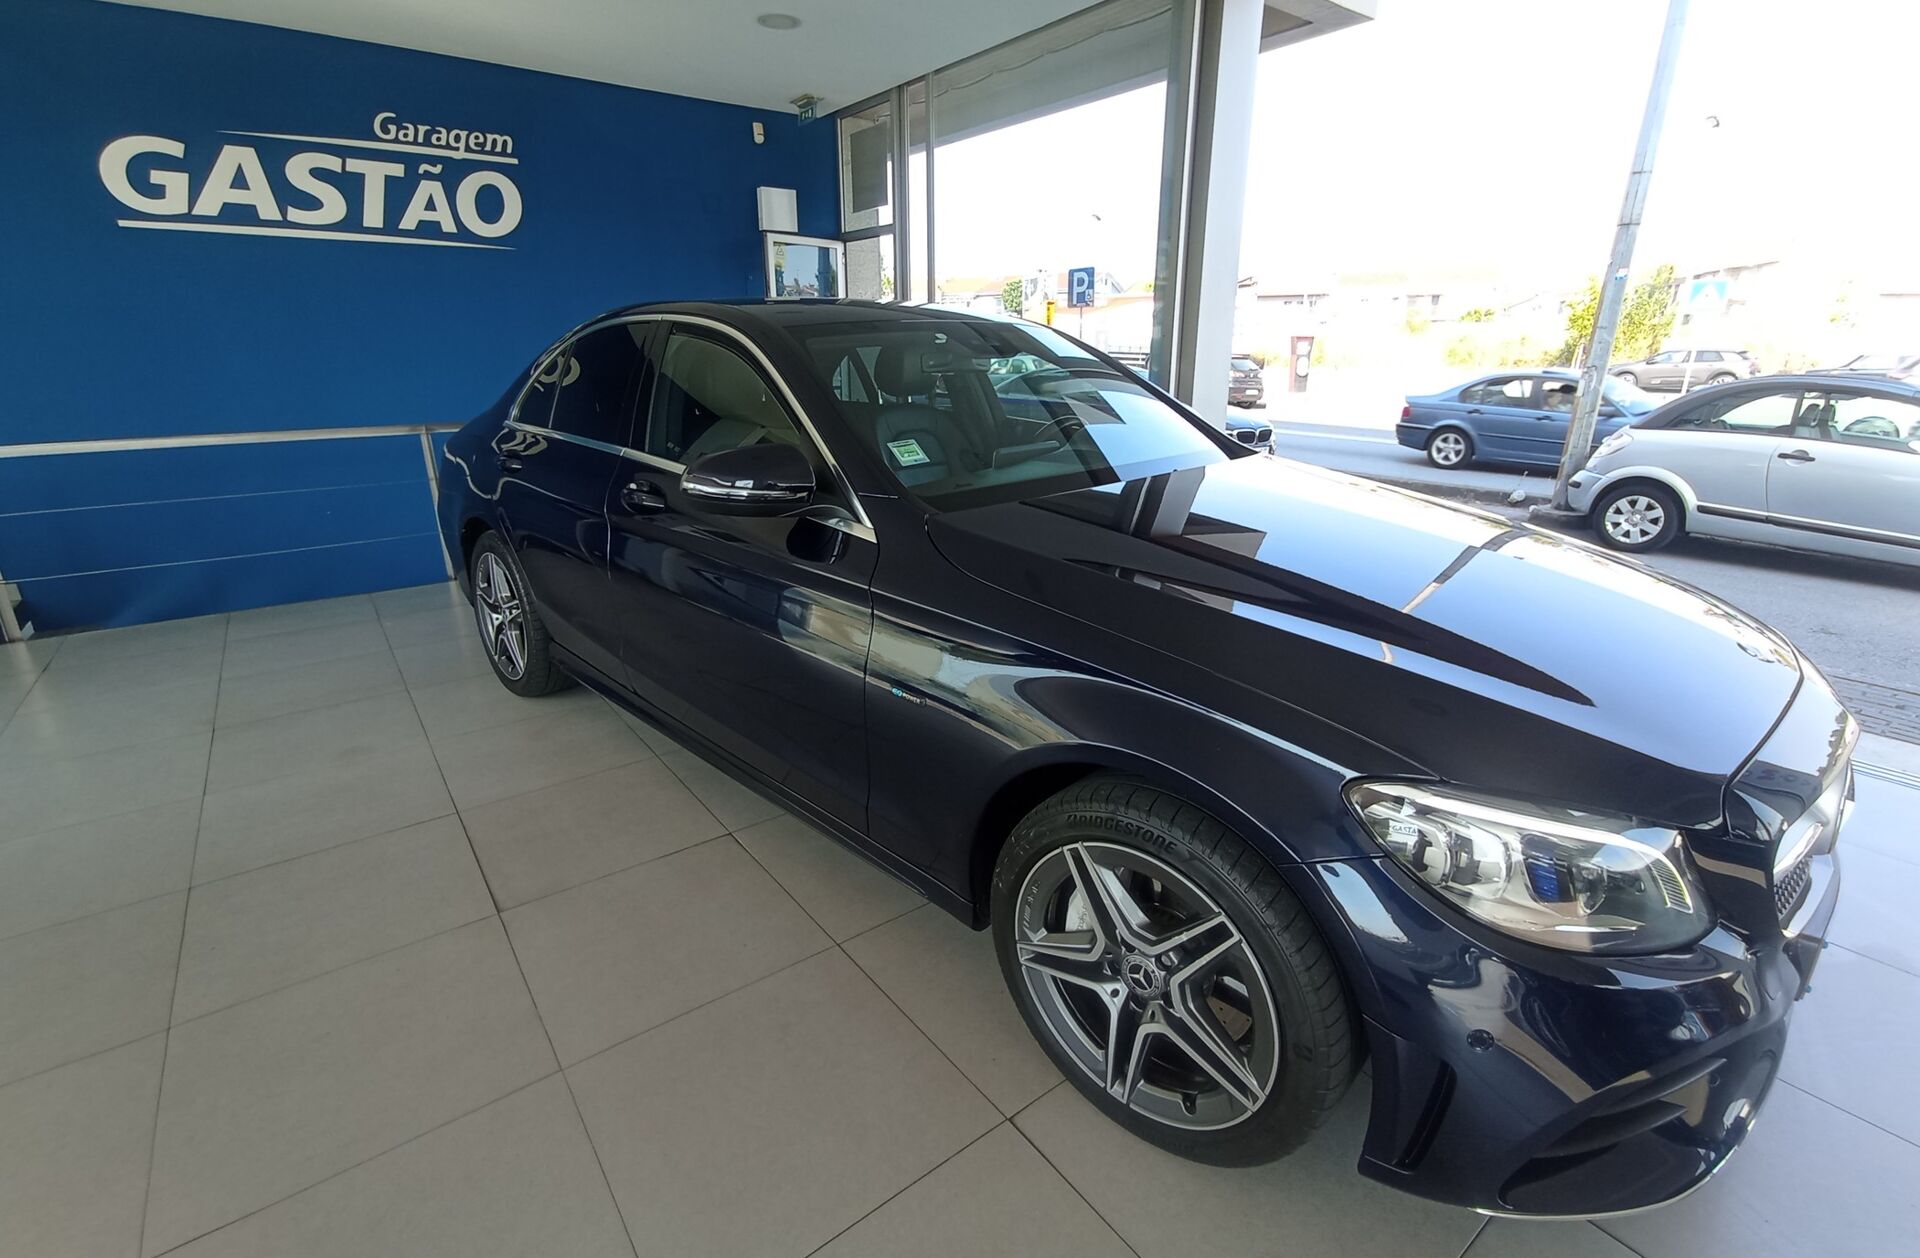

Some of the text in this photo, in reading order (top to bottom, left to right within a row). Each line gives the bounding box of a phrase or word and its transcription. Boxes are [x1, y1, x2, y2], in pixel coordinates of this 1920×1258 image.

[373, 112, 513, 159] Garagem
[99, 135, 523, 238] GASTÃO
[1072, 271, 1089, 305] P
[1066, 813, 1177, 855] BRIDGESTONE
